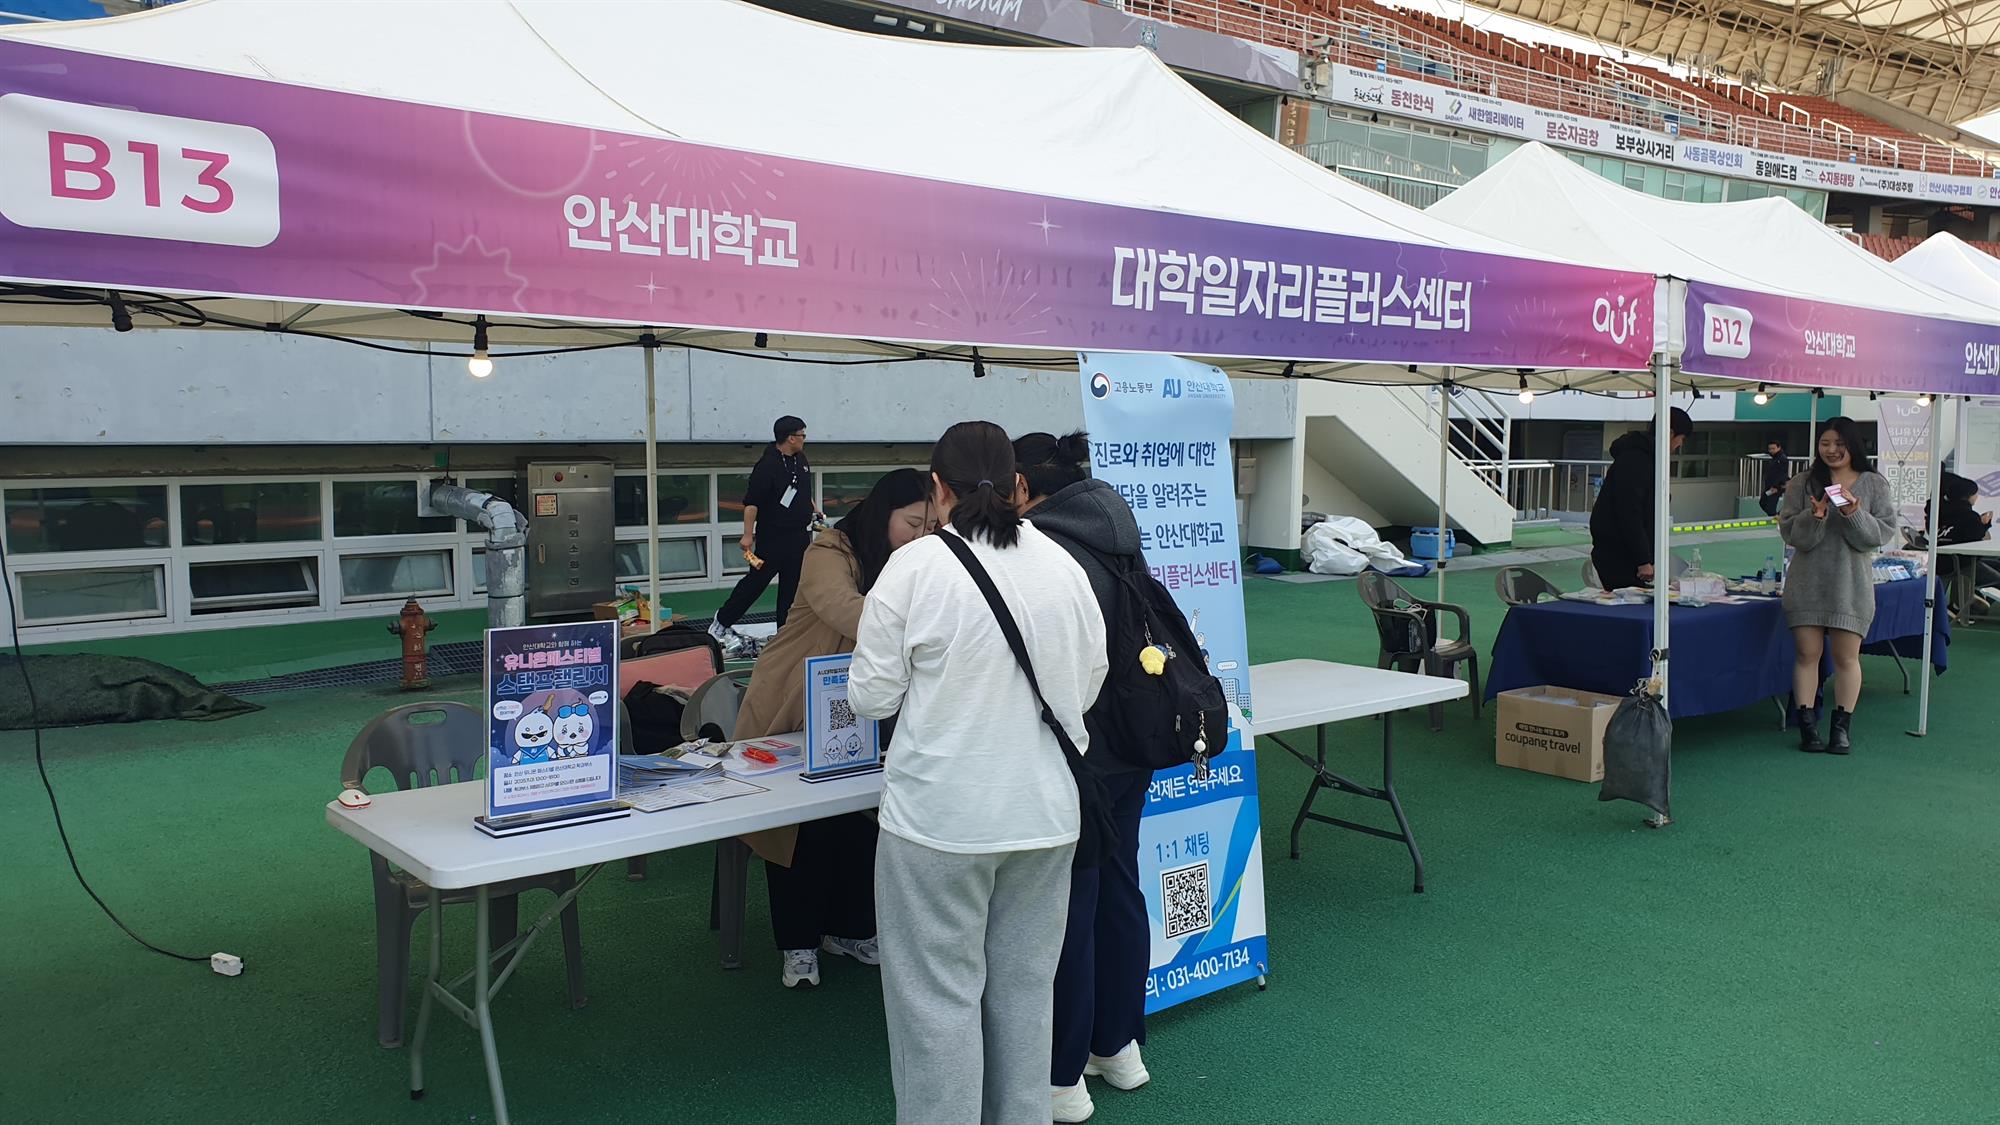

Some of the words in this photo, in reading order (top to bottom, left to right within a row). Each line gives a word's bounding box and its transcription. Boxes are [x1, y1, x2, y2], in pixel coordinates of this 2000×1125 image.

[1391, 89, 1434, 113] 동천한식
[1468, 106, 1524, 130] 새한엘리베이터
[1546, 121, 1599, 147] 문순자곱창
[1616, 133, 1674, 161] 보부상사거리
[1683, 145, 1743, 168] 사동골목상인회
[48, 131, 234, 214] B13
[1755, 159, 1797, 181] 동일애드컴
[1819, 170, 1855, 187] 수지동태탕
[1878, 178, 1914, 193] (주)대성주방
[1929, 182, 1972, 196] 안산시축구협회
[563, 194, 799, 268] 안산대학교
[1112, 246, 1472, 332] 대학일자리플러스센터
[1711, 316, 1744, 346] B12
[1804, 329, 1856, 358] 안산대학교
[1965, 342, 2000, 376] 안산대
[1114, 381, 1153, 394] 고용노동부
[1162, 378, 1182, 399] AU
[1187, 380, 1226, 394] 안산대학교
[1095, 441, 1139, 468] 진로와
[1142, 442, 1185, 467] 취업에
[1188, 441, 1216, 467] 대한
[1112, 483, 1148, 509] 답을
[1152, 483, 1207, 508] 알려주는
[1155, 522, 1225, 549] 안산대학교
[1148, 560, 1237, 590] 리플러스센터
[504, 647, 602, 671] 유니온페스티벌
[523, 641, 557, 651] 안산대학교와
[497, 664, 609, 695] 스탬프챌린지
[1505, 732, 1548, 751] coupang
[1549, 739, 1581, 754] travel
[1148, 776, 1186, 802] 언제든
[1156, 840, 1178, 863] 1:1
[1185, 831, 1210, 857] 채팅
[1167, 946, 1250, 990] 031-400-7134
